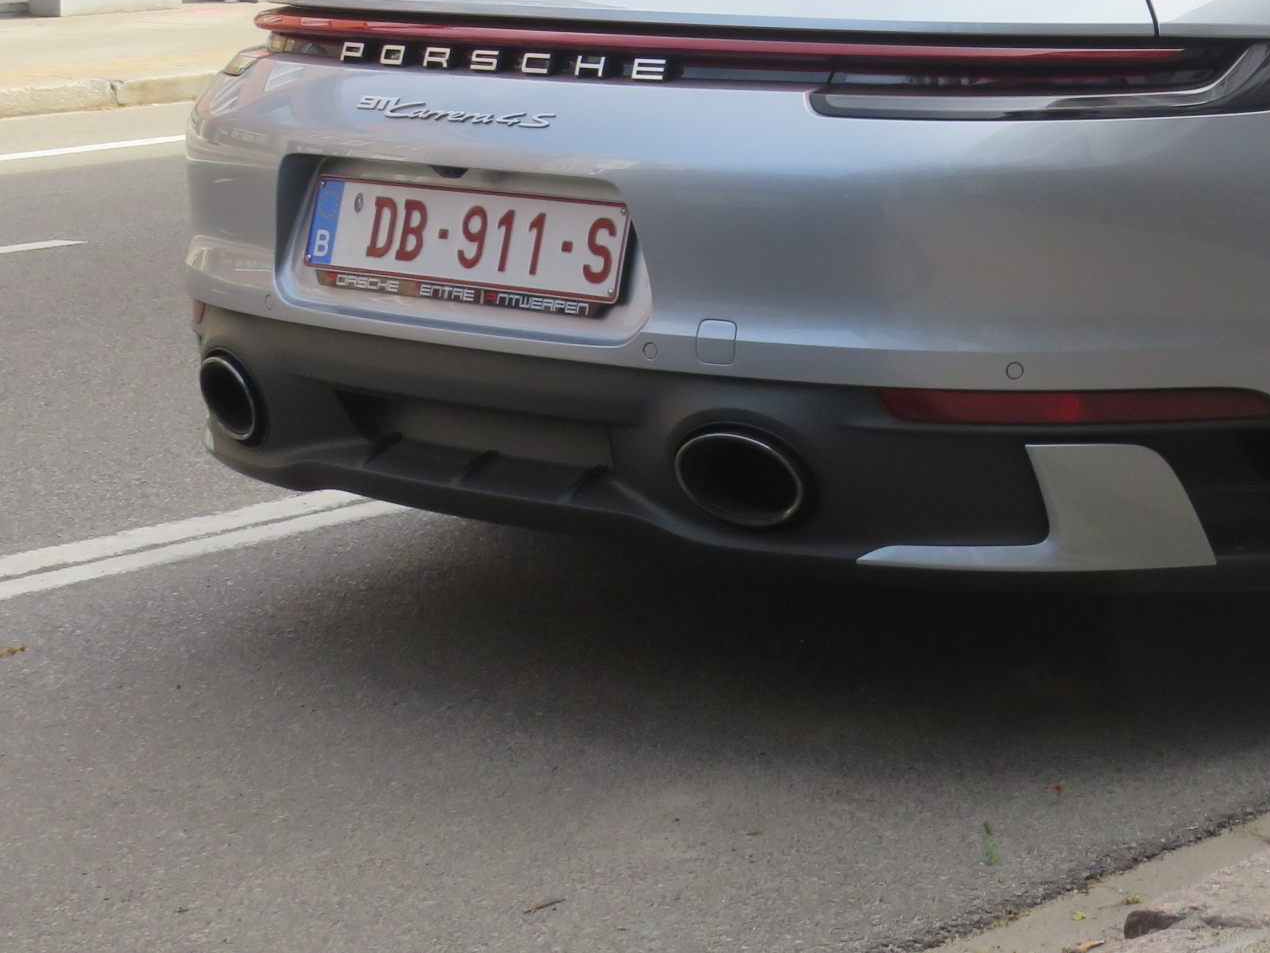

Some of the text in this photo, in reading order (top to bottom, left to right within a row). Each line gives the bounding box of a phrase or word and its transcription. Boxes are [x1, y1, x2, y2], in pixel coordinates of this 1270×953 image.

[340, 41, 668, 81] PORSCHE
[356, 95, 400, 111] 911
[384, 101, 494, 125] Carrera
[313, 229, 330, 257] B
[325, 272, 399, 292] PORSCHE
[485, 292, 590, 316] ANTWERPEN
